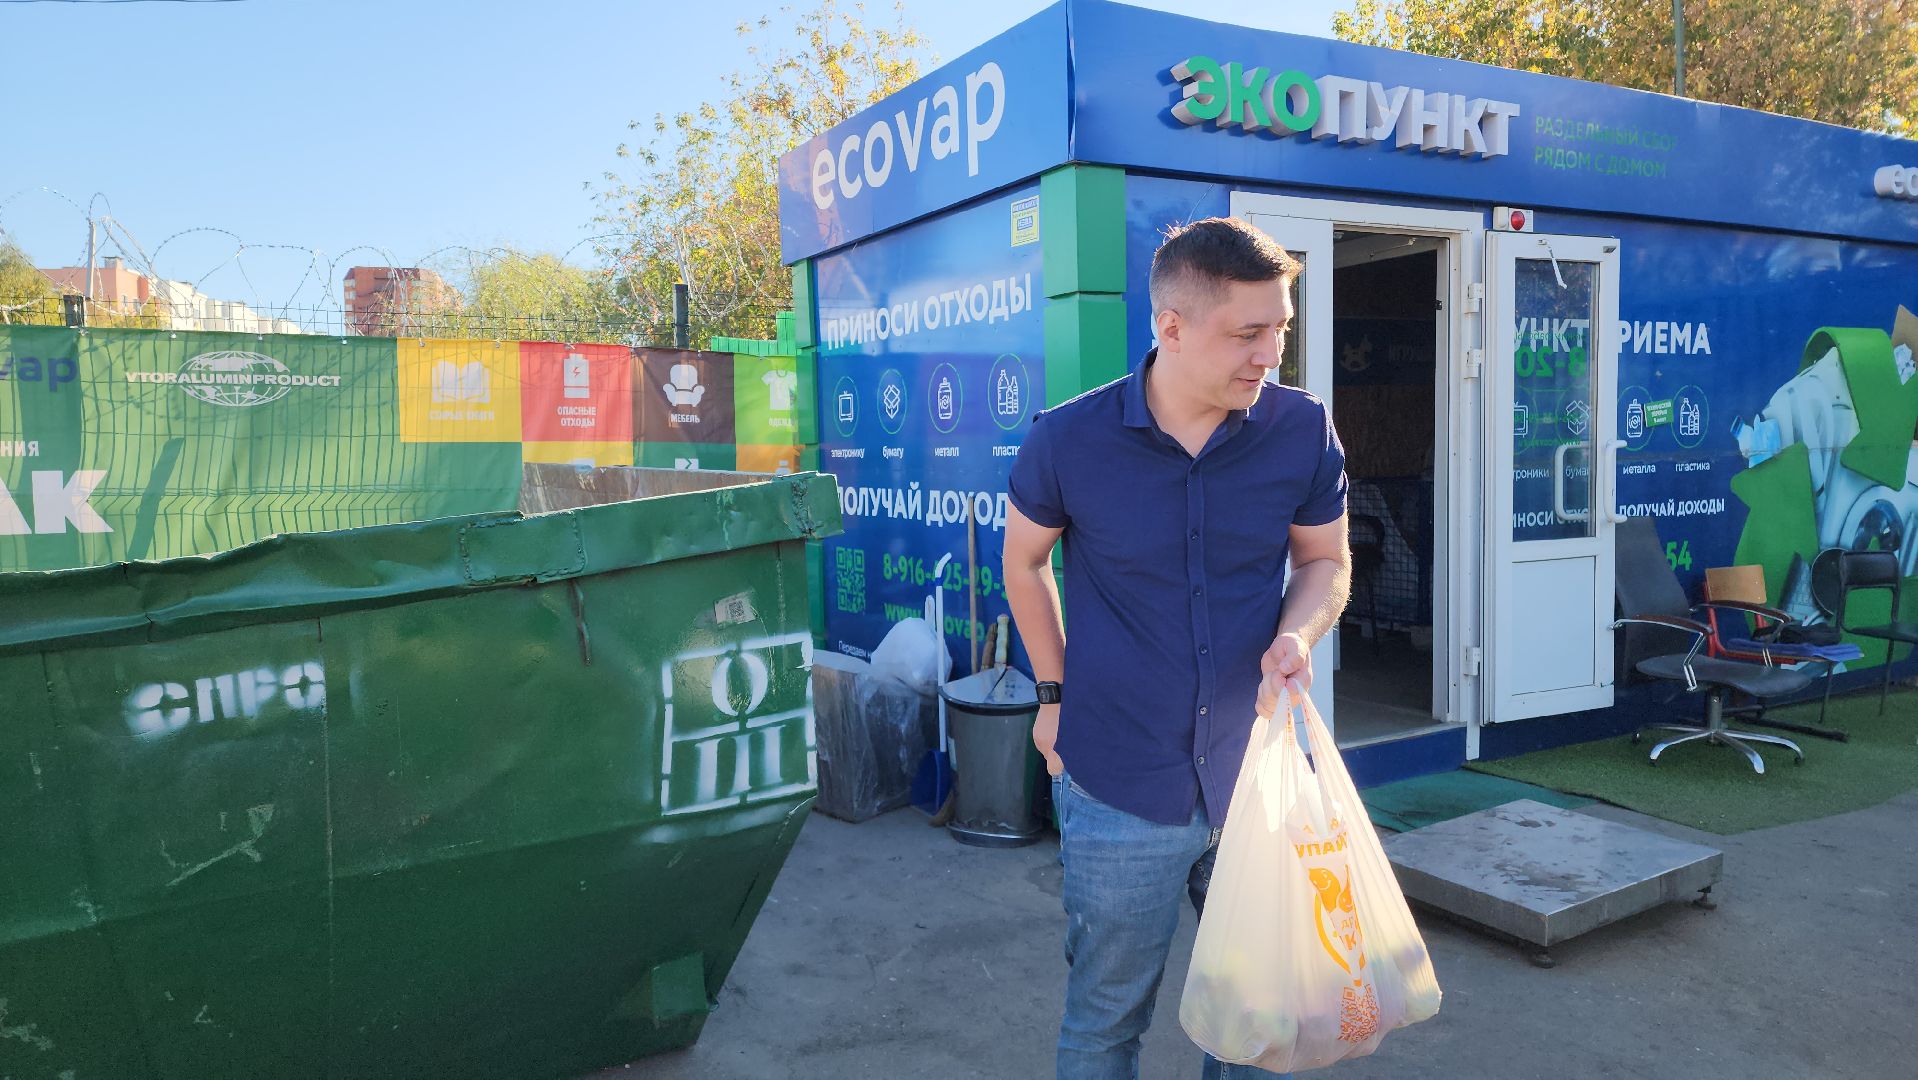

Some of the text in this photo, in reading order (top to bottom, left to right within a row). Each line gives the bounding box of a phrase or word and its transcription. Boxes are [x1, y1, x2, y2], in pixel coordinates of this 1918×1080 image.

[1171, 56, 1520, 159] ЭКОПУНКТ
[812, 62, 1005, 209] ecovap
[1535, 146, 1591, 170] РЯДОМ
[1606, 155, 1666, 178] ДОМОМ
[827, 272, 1032, 350] ПРИНОСИ ОТХОДЫ
[125, 371, 341, 387] VTORALUMINPRODUCT
[557, 406, 597, 416] ОПАСНЫЕ
[670, 413, 701, 424] МЕБЕЛЬ
[560, 417, 596, 428] ОТХОДЫ
[883, 445, 904, 460] бумагу
[1676, 498, 1725, 517] ДОХОДЫ
